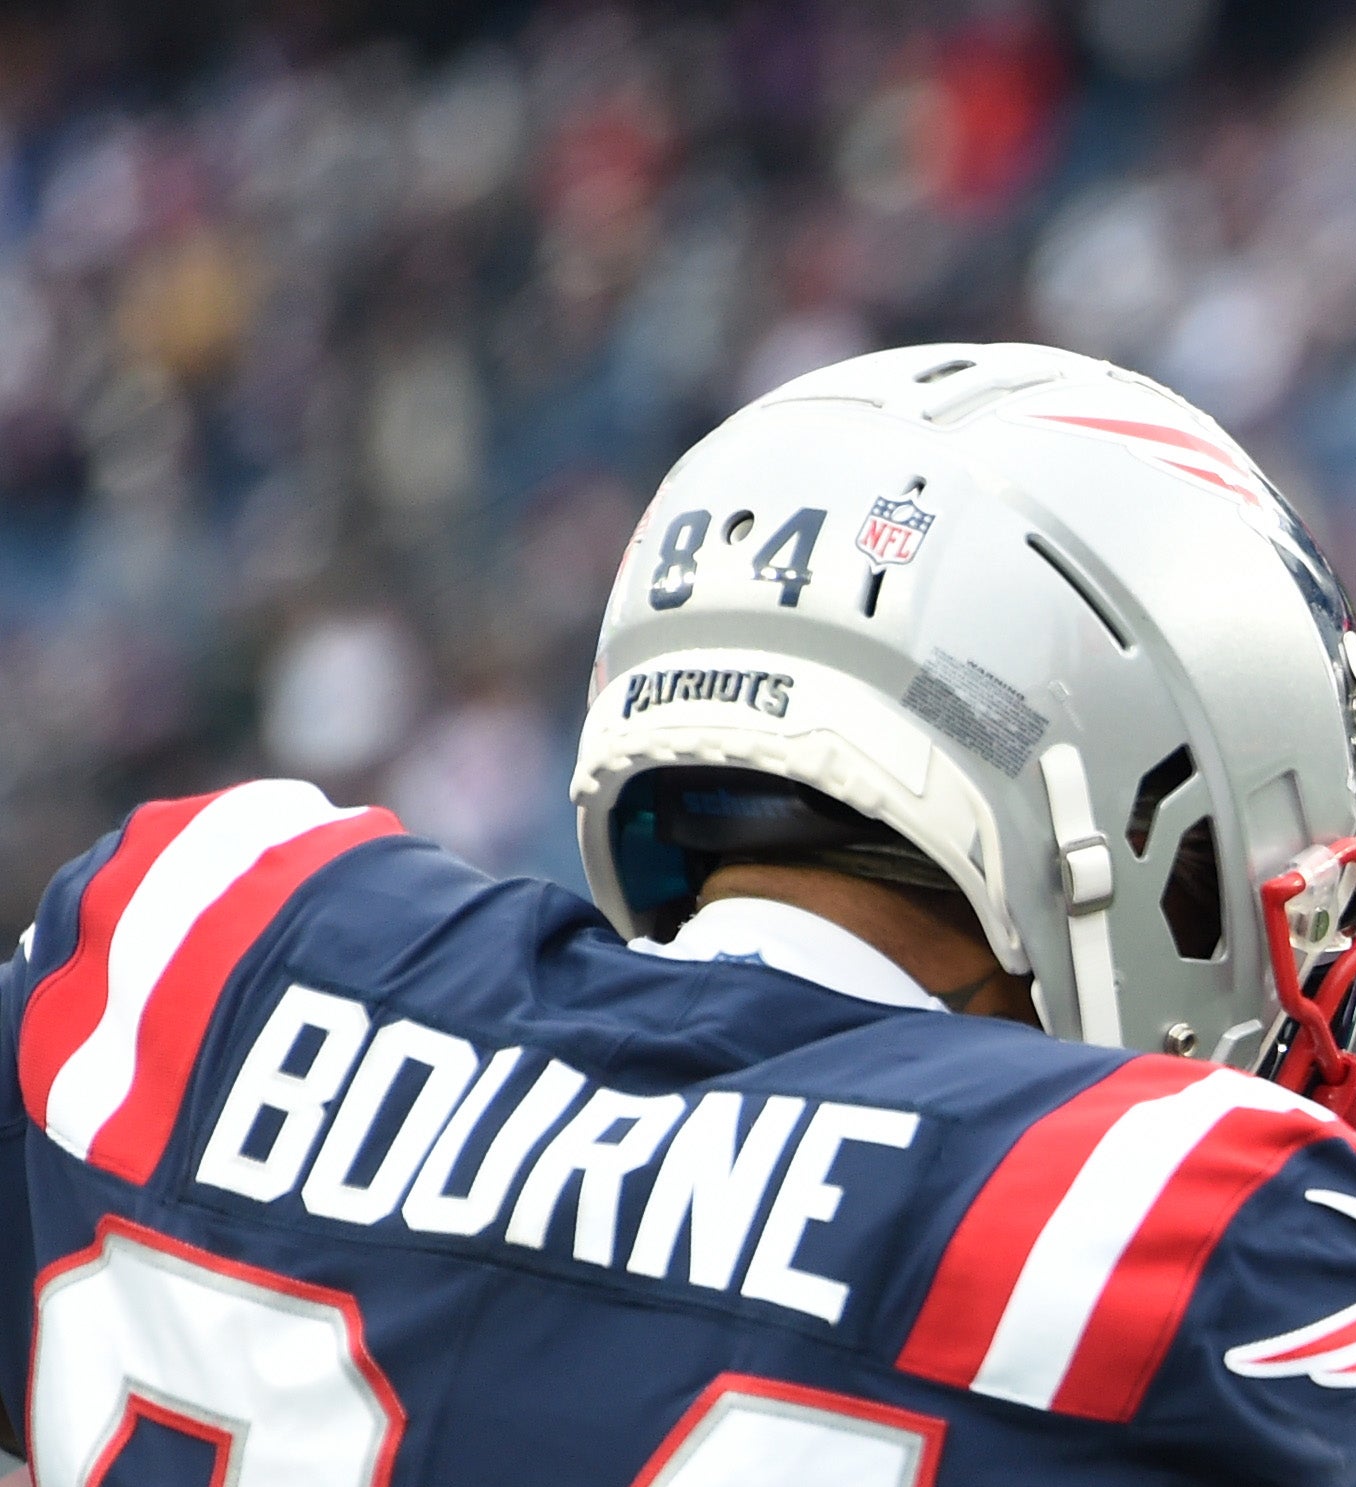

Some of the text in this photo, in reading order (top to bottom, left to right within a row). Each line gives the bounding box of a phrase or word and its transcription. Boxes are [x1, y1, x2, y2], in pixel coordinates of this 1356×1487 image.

[648, 507, 828, 612] 84
[861, 519, 914, 560] NFL
[622, 668, 795, 720] PATRIOTS
[196, 982, 920, 1325] BOURNE
